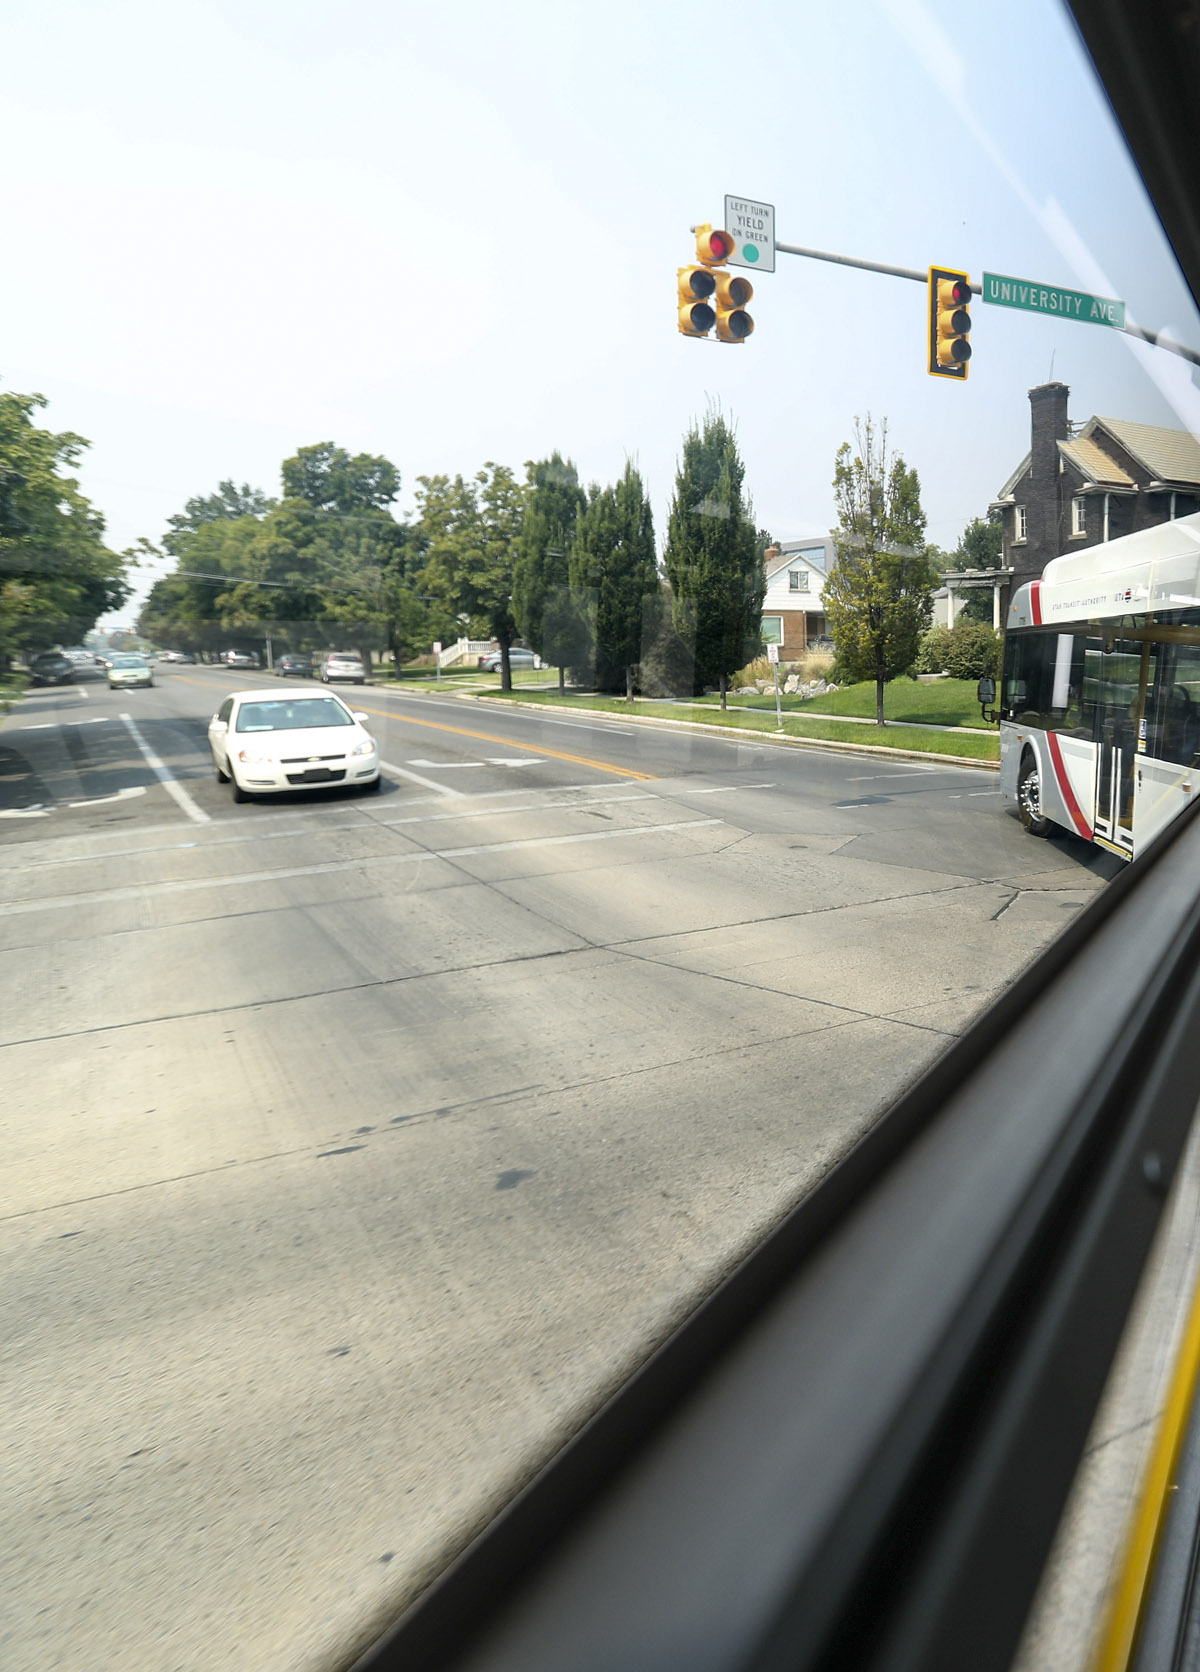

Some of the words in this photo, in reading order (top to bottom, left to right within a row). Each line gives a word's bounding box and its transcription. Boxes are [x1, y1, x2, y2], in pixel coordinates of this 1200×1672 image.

[730, 202, 748, 212] LEFT
[751, 206, 769, 217] TURN
[737, 215, 764, 230] YIELD
[732, 228, 742, 237] ON
[745, 231, 768, 242] GREEN
[990, 280, 1082, 314] UNIVERSITY
[1090, 302, 1119, 321] AVE.
